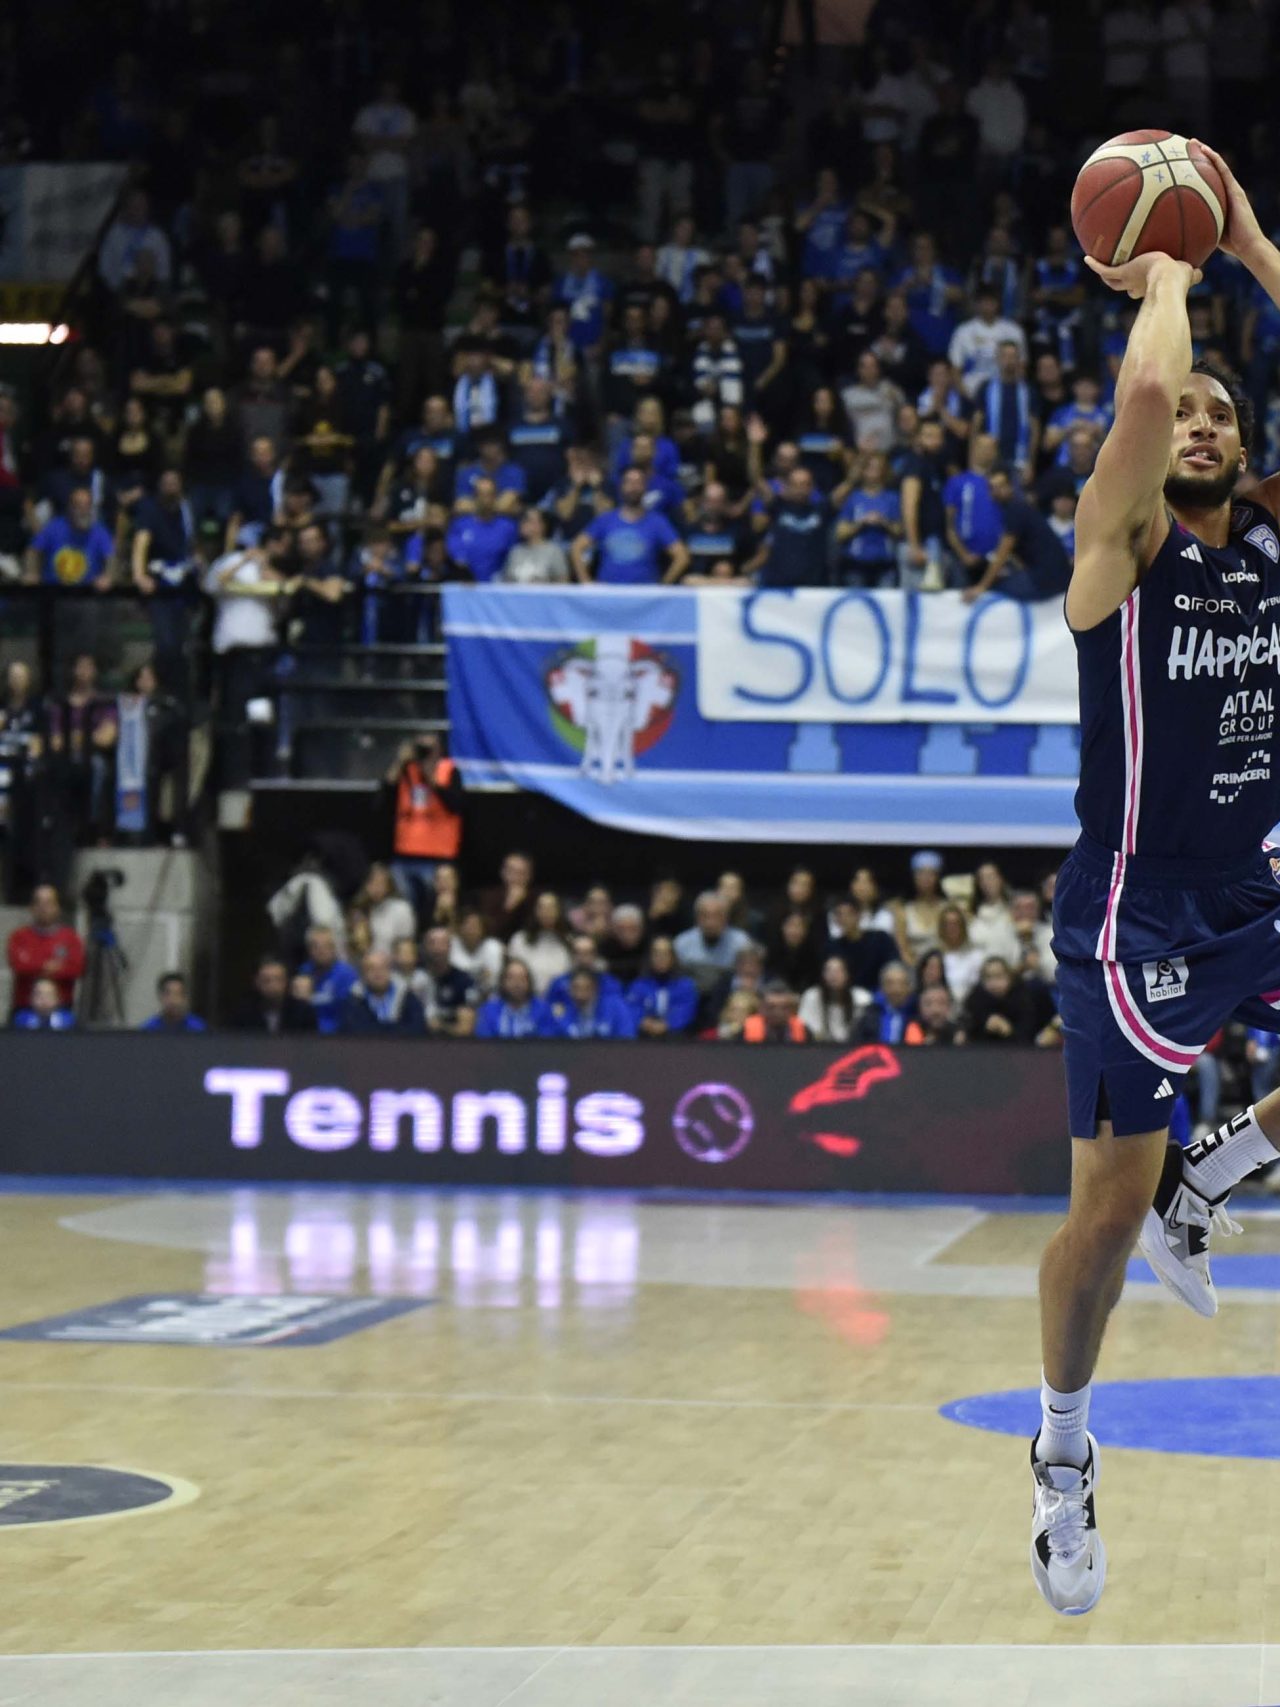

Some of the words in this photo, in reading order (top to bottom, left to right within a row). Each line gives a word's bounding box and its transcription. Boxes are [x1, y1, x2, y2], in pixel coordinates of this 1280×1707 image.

[732, 588, 1036, 708] SOLO
[1219, 714, 1274, 736] GROUP
[1150, 984, 1182, 999] habitat
[205, 1067, 645, 1157] Tennis
